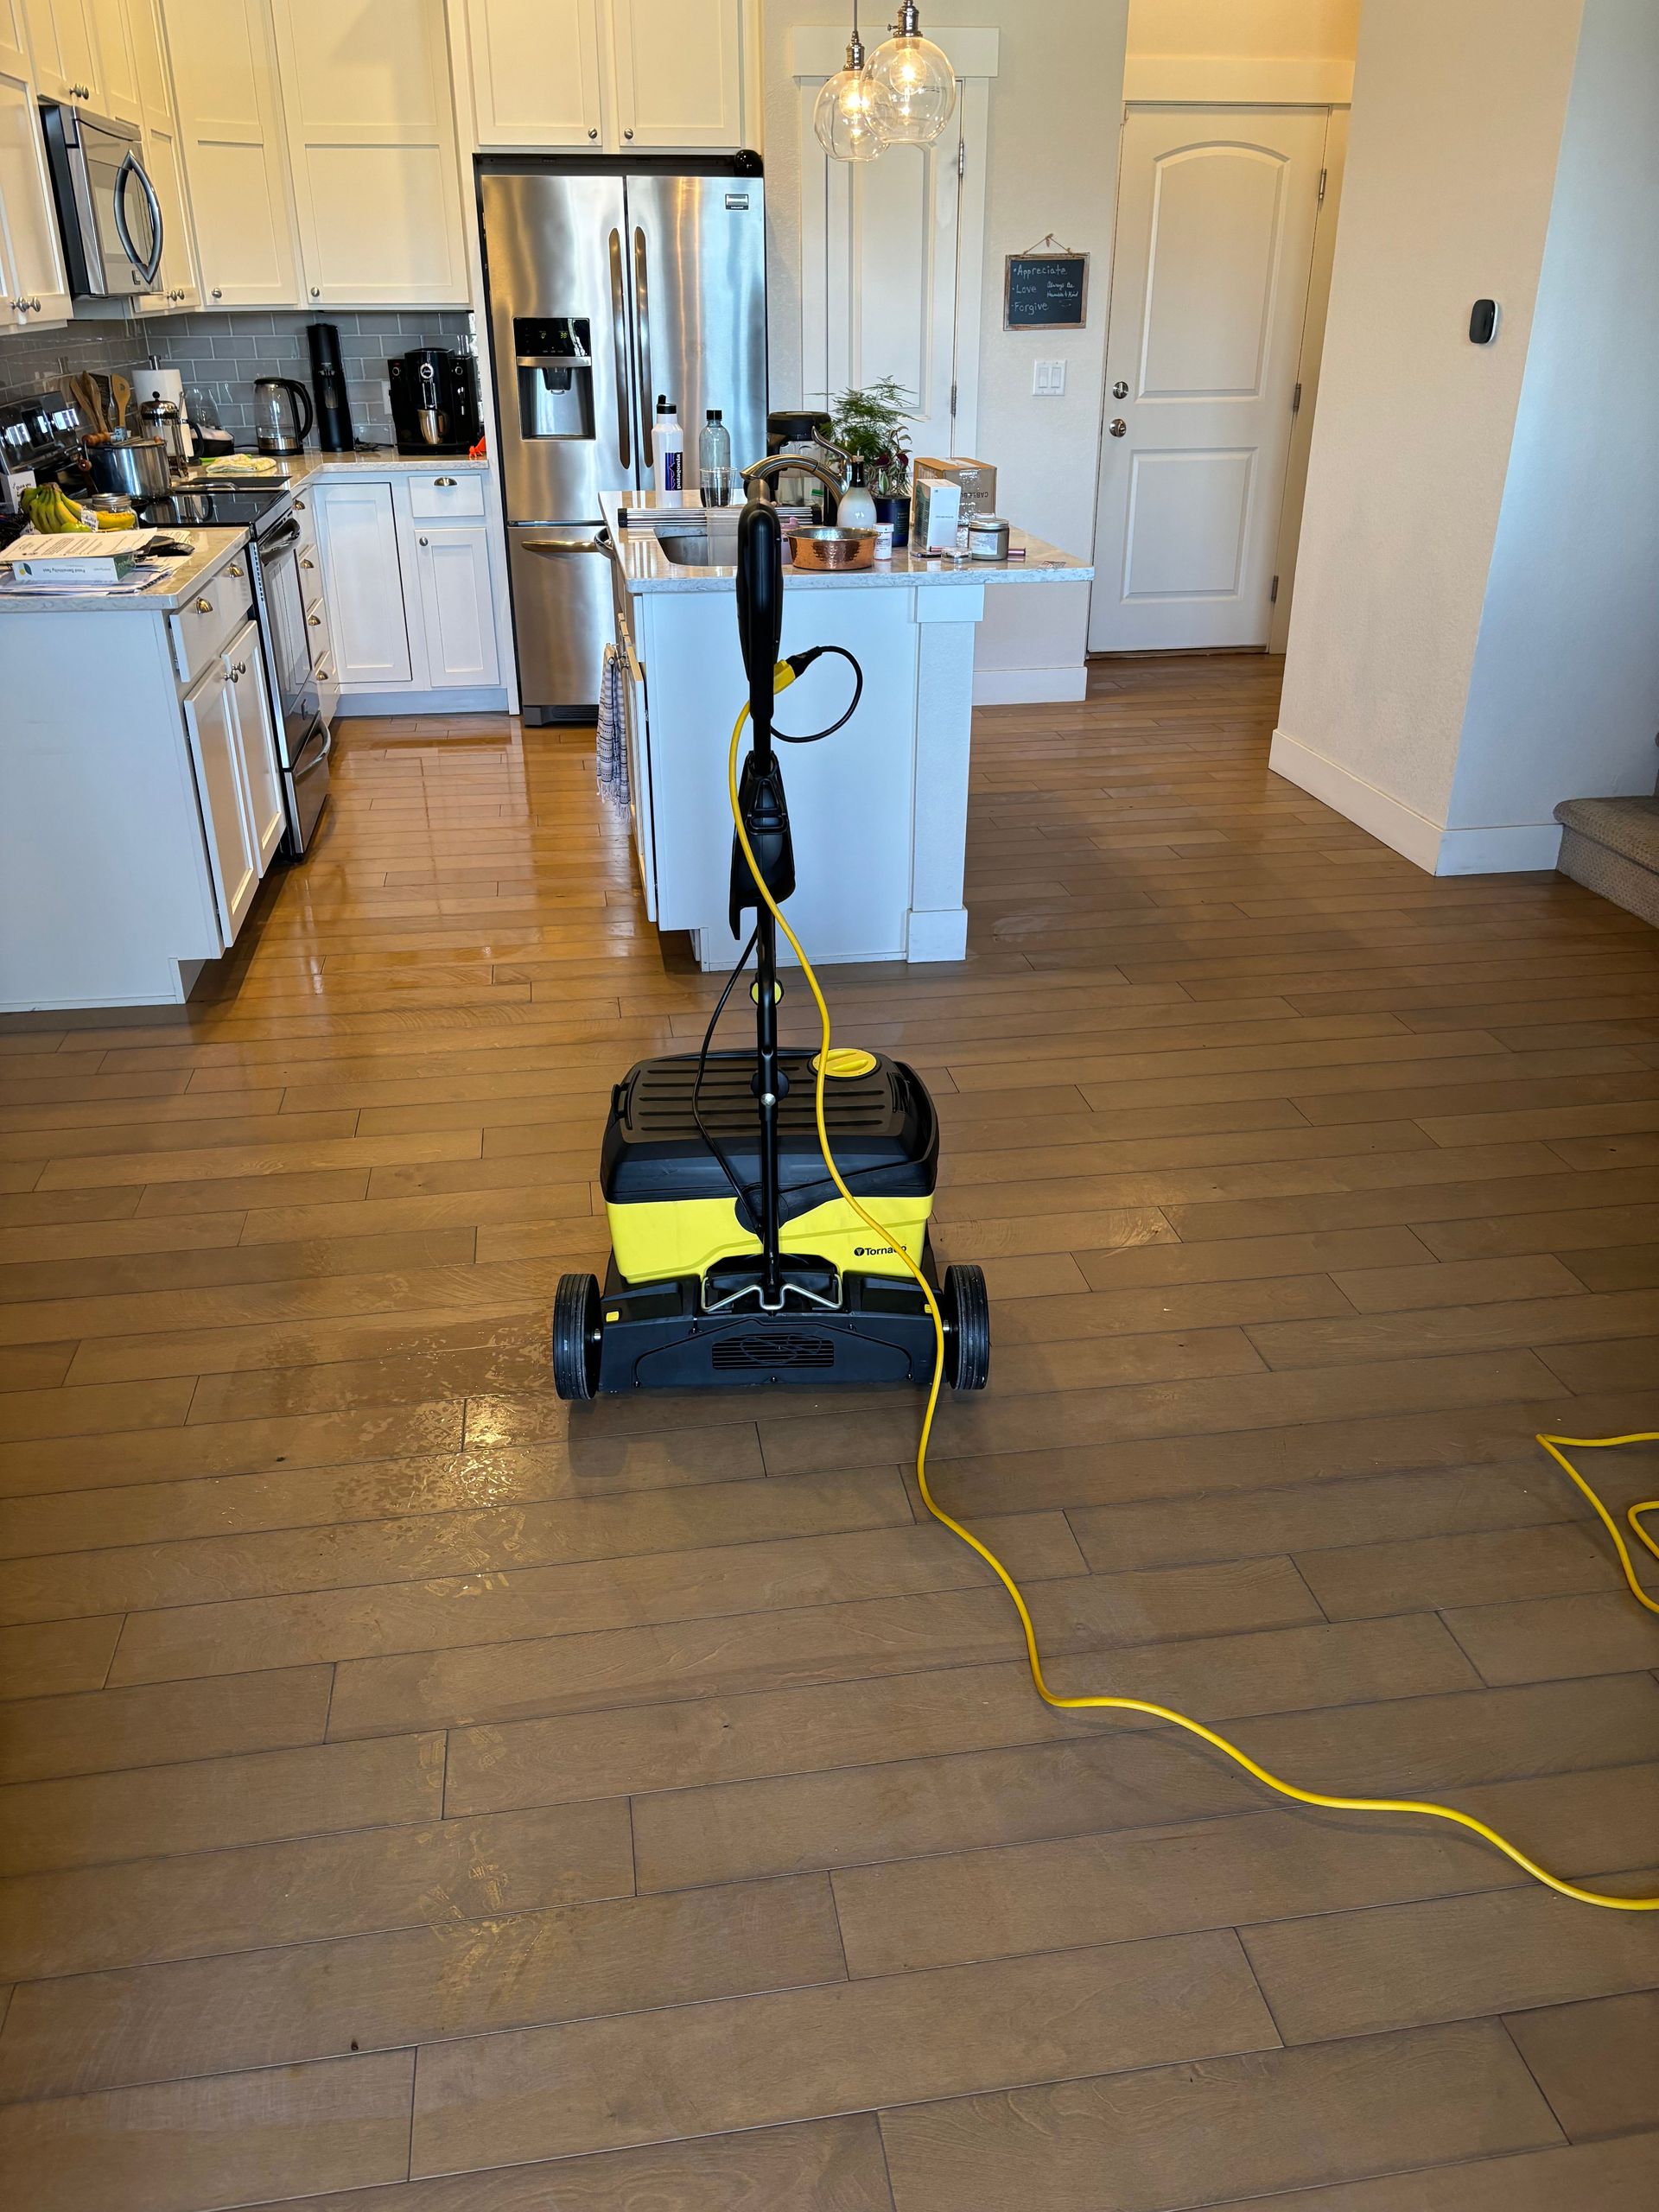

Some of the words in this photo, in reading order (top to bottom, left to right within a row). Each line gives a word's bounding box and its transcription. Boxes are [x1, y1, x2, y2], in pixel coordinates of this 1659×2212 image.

[1017, 264, 1067, 280] Appreciate
[1016, 284, 1037, 294] Love
[1014, 302, 1049, 315] Forgive
[865, 1245, 907, 1256] Tornao
